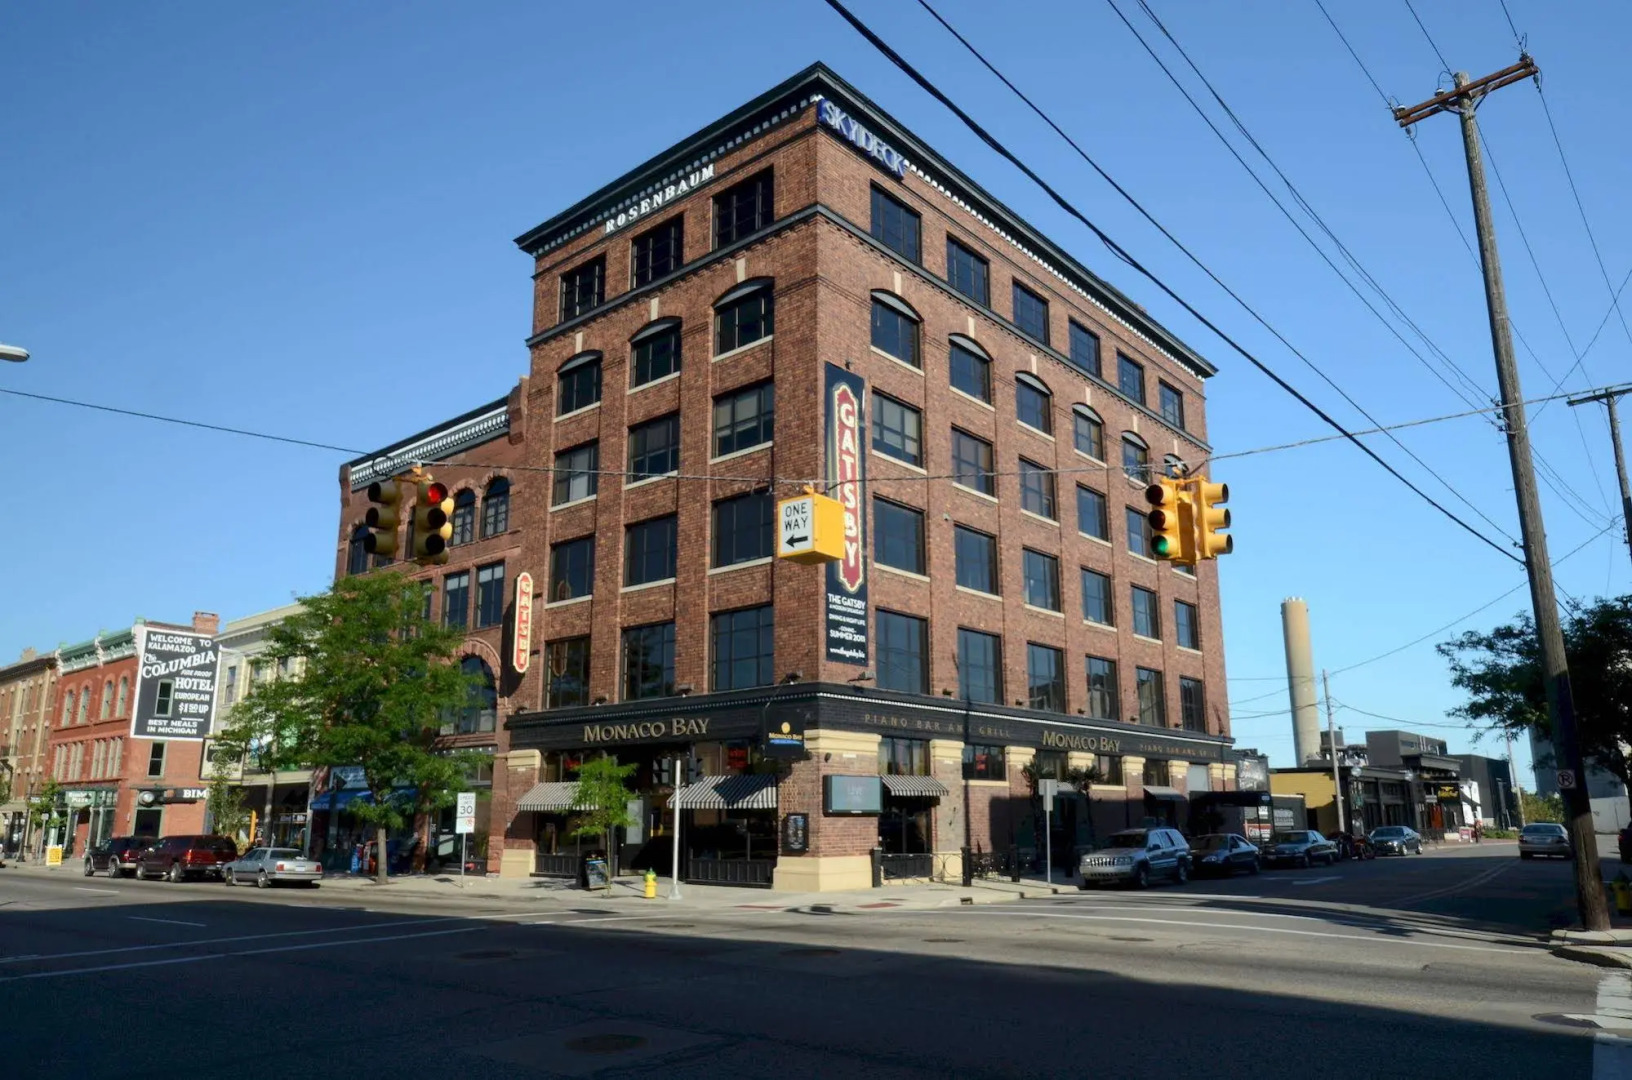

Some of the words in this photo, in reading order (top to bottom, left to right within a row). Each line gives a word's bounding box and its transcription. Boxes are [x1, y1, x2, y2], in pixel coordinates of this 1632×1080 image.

[823, 100, 905, 177] SKYDECK
[604, 163, 714, 234] ROSENBAUM
[839, 403, 858, 567] GATSBY
[785, 503, 807, 518] ONE
[784, 516, 809, 532] WAY
[828, 593, 841, 605] THE
[841, 597, 866, 609] GATSBY
[518, 581, 531, 664] GATSBY
[150, 633, 193, 645] WELCOME
[199, 639, 212, 647] TO
[829, 629, 853, 640] SUMMER
[148, 642, 196, 653] KALAMAZOO
[142, 651, 216, 678] COLUMBIA
[174, 677, 214, 691] HOTEL
[174, 692, 210, 701] EUROPEAN
[198, 704, 209, 714] UP
[171, 720, 198, 728] MEALS
[583, 722, 666, 743] MONACO
[671, 717, 710, 736] BAY
[864, 714, 907, 728] PIANO
[916, 720, 940, 731] BAR
[979, 726, 1011, 738] GRILL
[1042, 730, 1097, 750] MONACO
[1101, 737, 1121, 752] BAY
[460, 805, 473, 815] 30
